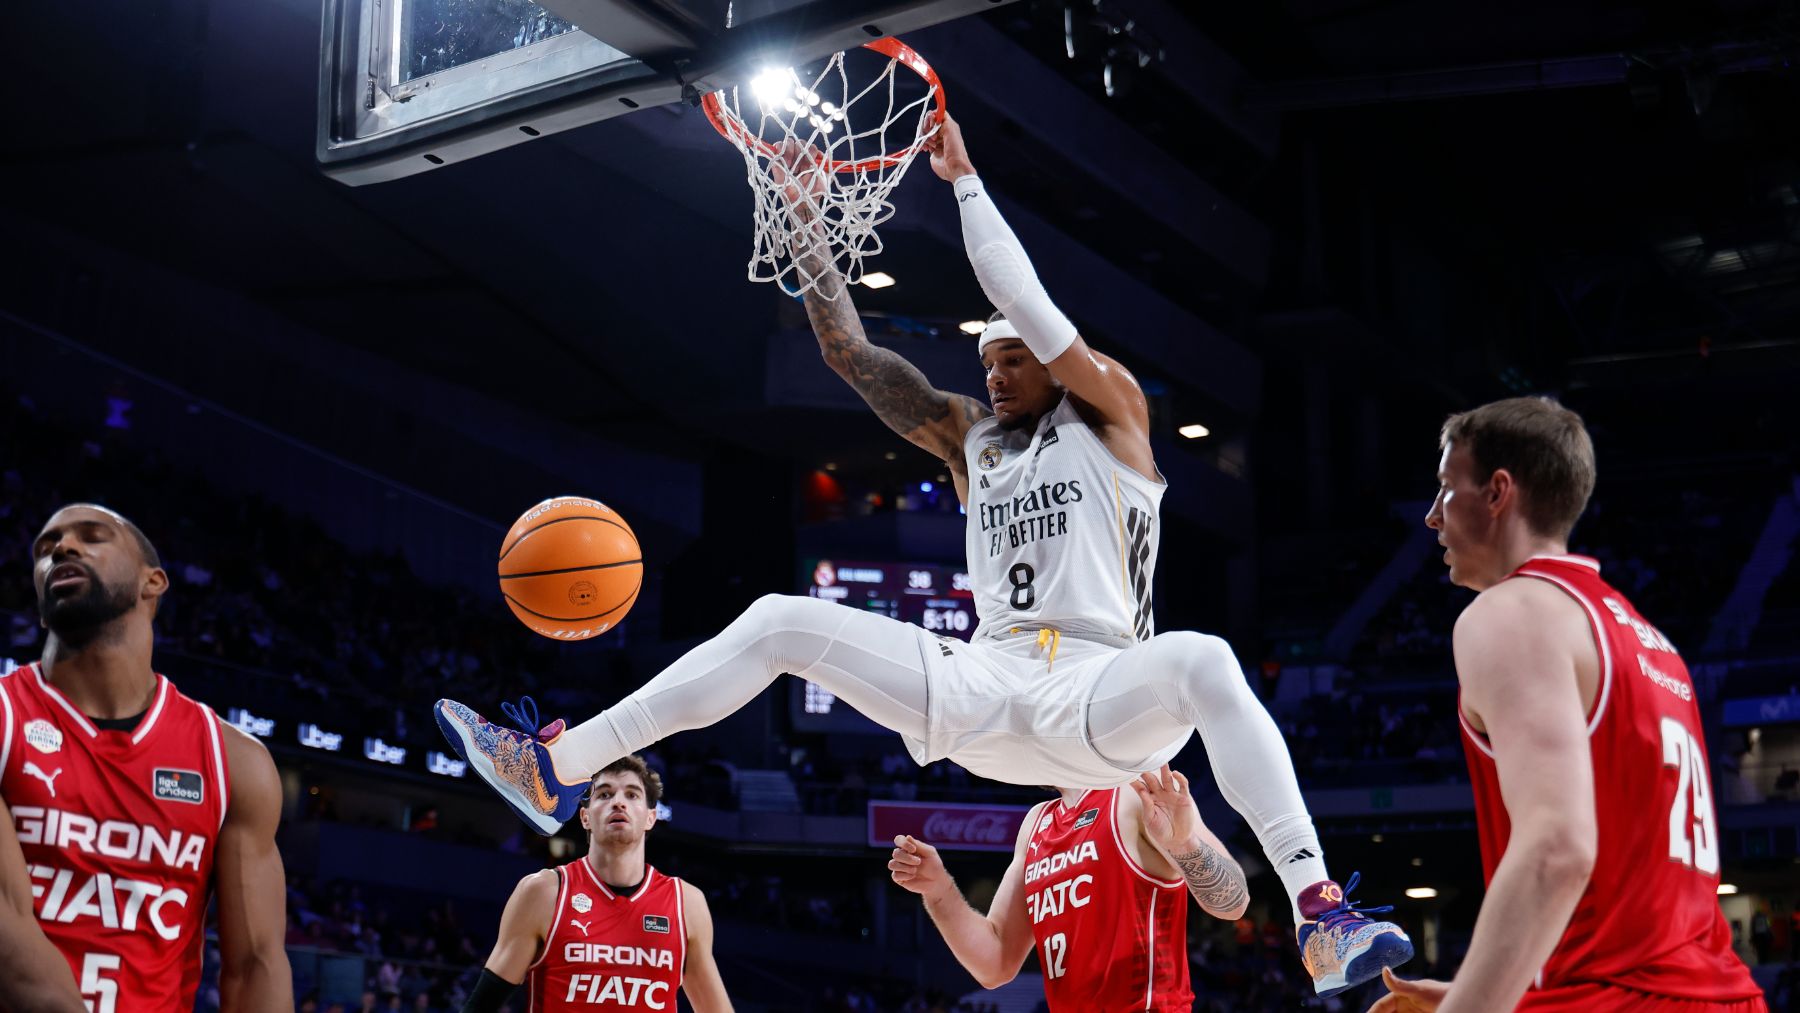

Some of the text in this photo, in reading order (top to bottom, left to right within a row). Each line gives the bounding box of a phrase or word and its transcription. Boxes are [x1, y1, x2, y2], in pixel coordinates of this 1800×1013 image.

[980, 480, 1083, 532] Emrates
[1008, 511, 1067, 549] BETTER
[1008, 562, 1035, 611] 8
[923, 609, 969, 632] 5:10
[228, 707, 274, 737] Uber
[298, 722, 342, 750] Uber
[364, 736, 405, 764] Uber
[426, 751, 467, 777] Uber
[159, 776, 178, 787] liga
[159, 787, 200, 799] endesa
[1661, 717, 1719, 875] 29
[11, 806, 206, 872] GIRONA
[1024, 840, 1099, 885] GIRONA
[564, 943, 673, 971] GIRONA
[1044, 932, 1067, 980] 12
[565, 974, 669, 1011] FIATC
